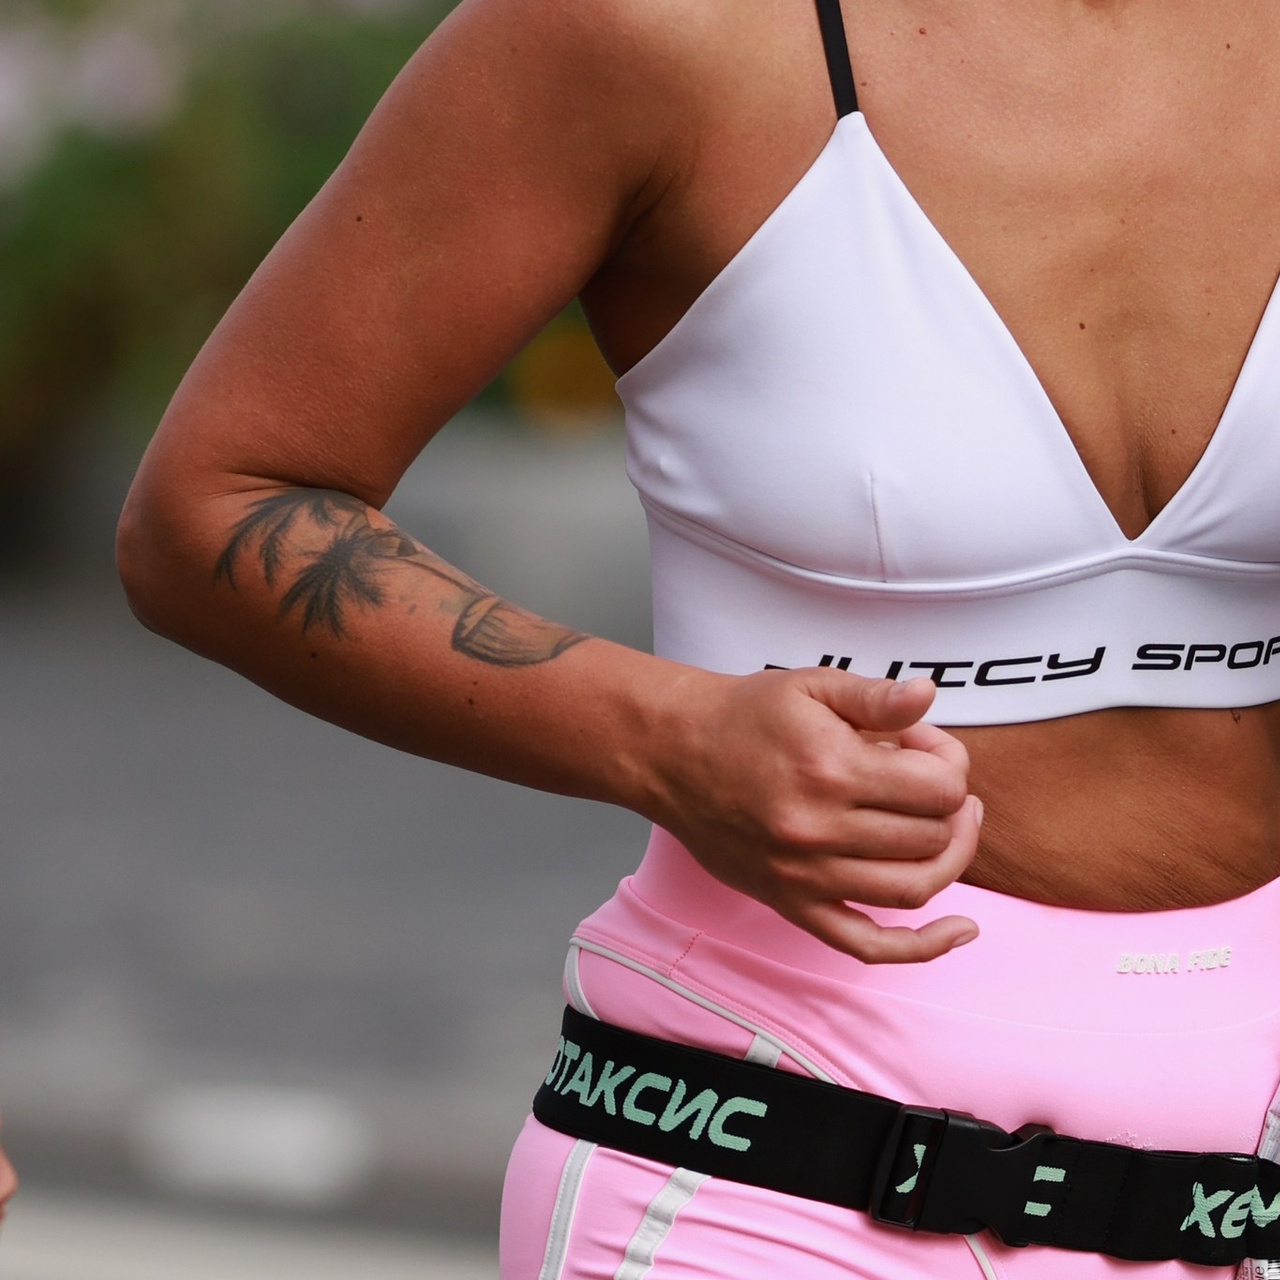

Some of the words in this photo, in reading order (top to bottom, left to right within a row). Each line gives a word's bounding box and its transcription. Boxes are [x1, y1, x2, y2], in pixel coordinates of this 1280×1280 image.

[764, 646, 1105, 688] ICY
[1117, 954, 1179, 974] BONA
[1187, 947, 1231, 970] FIDE
